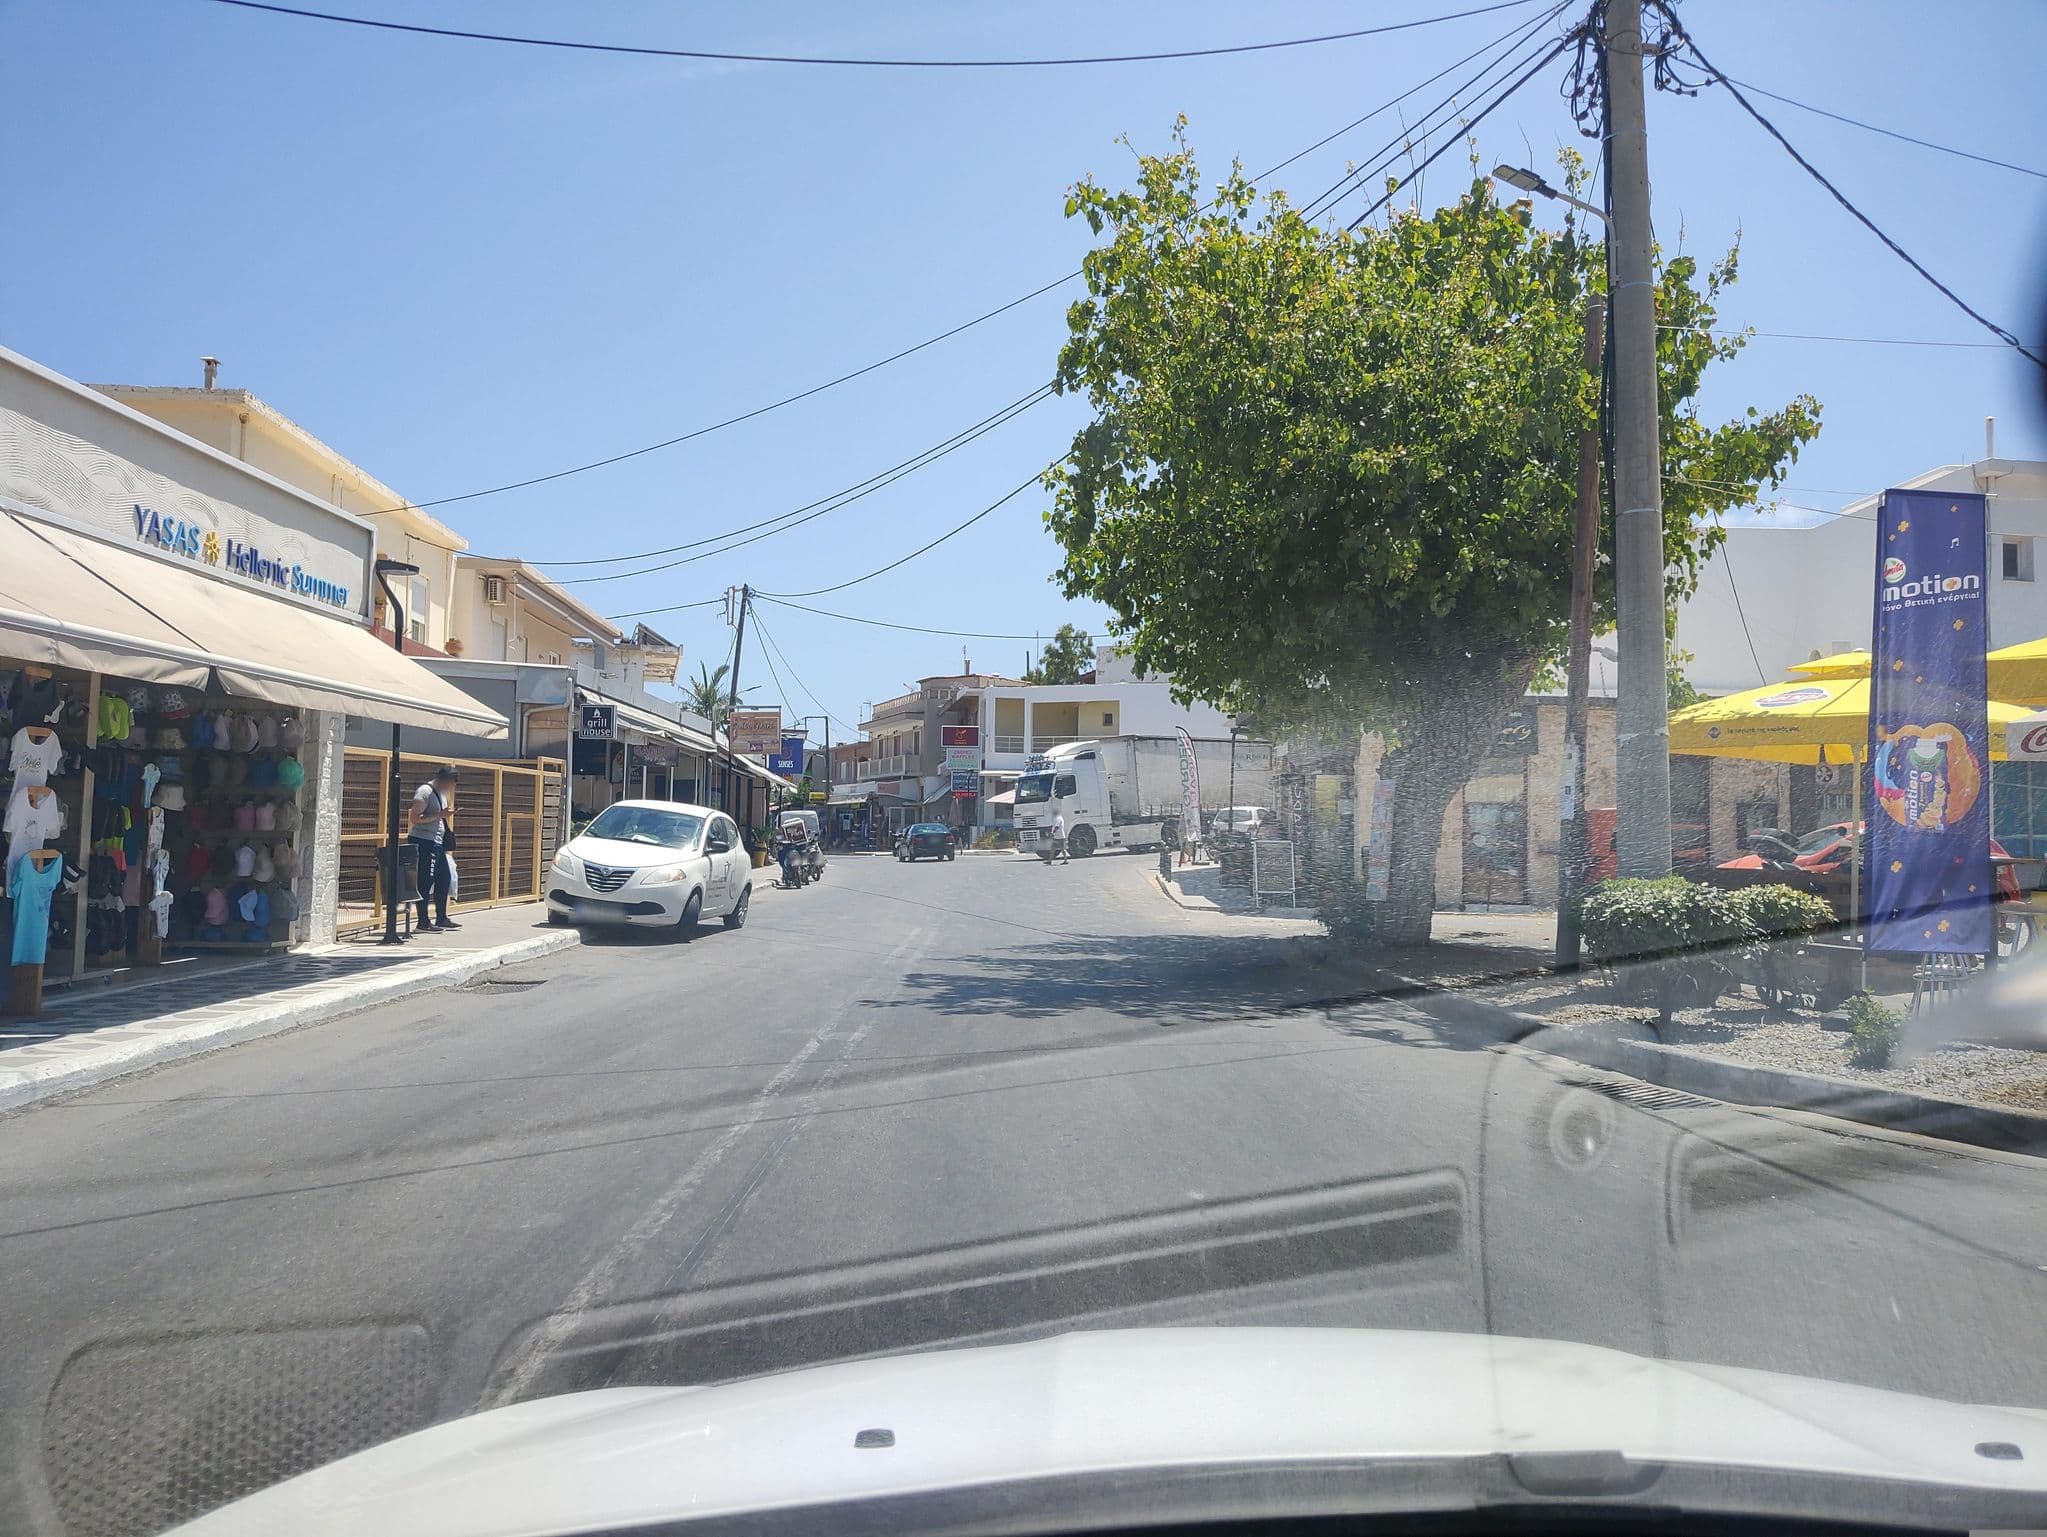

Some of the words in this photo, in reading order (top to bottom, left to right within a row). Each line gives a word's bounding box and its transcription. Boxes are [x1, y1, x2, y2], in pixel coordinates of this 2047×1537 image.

[133, 504, 200, 555] YASAS
[227, 538, 290, 586] Hellenic
[291, 563, 349, 605] Summer
[1883, 575, 1980, 602] motion
[1905, 597, 1935, 608] θετική
[587, 718, 608, 729] grill
[777, 760, 794, 768] SENSES
[1908, 770, 1918, 820] motion
